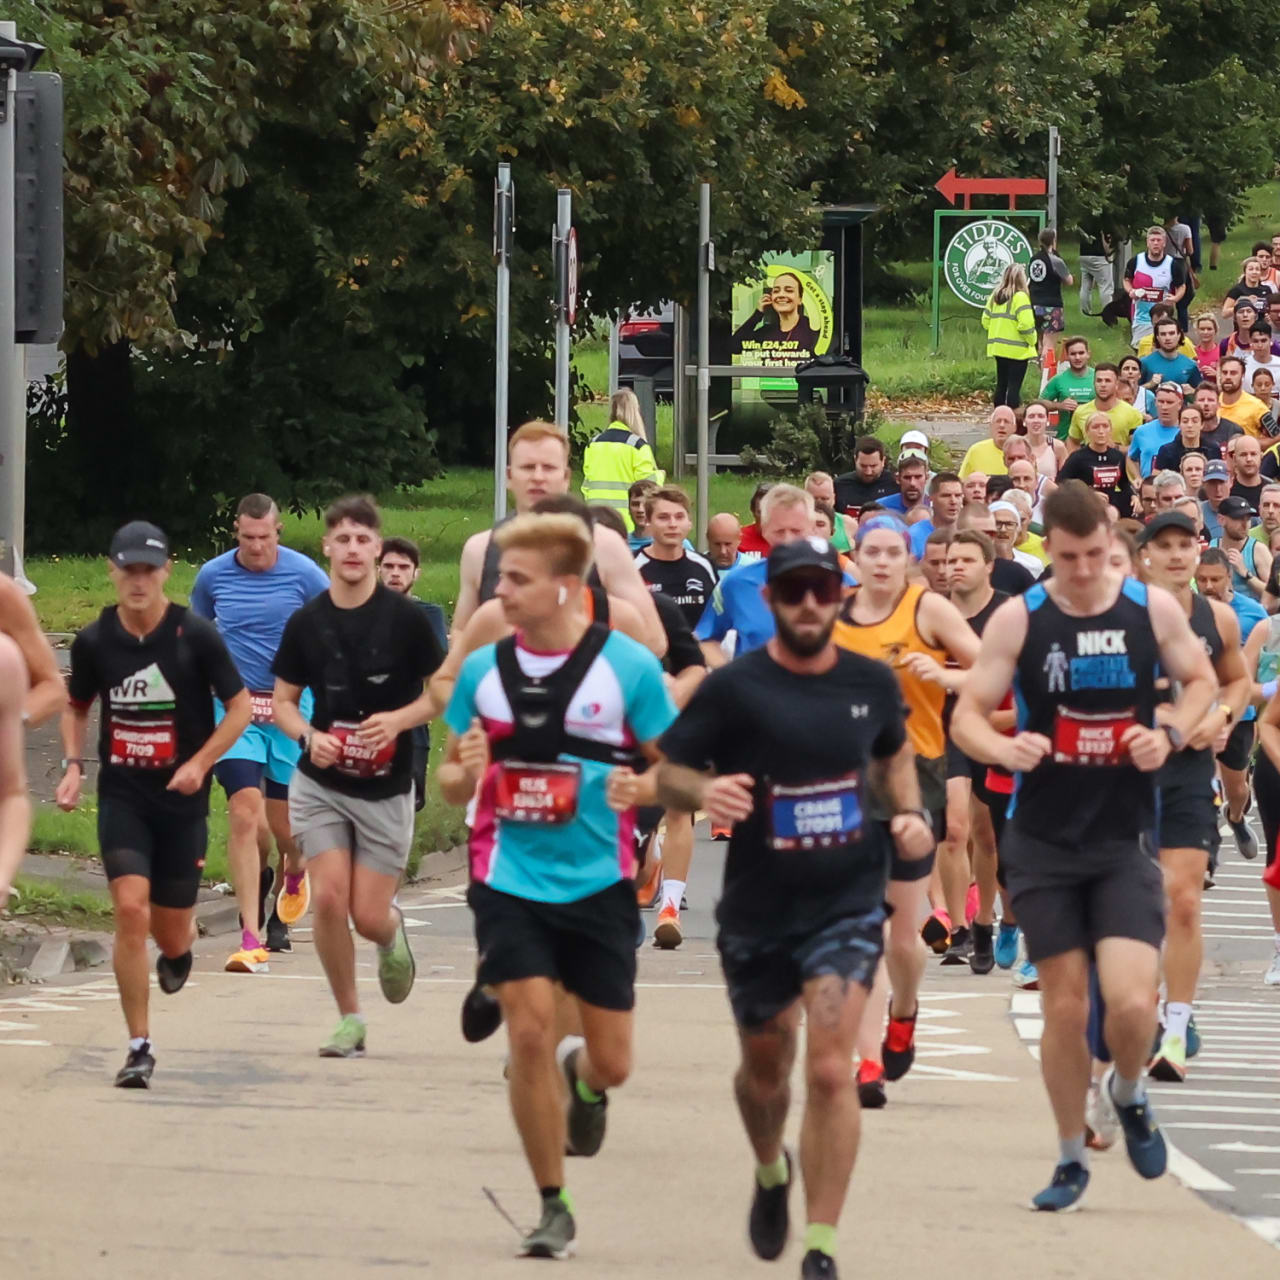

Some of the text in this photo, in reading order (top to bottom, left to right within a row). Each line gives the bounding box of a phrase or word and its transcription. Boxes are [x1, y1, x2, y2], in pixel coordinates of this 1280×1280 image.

[953, 223, 1026, 254] FIDDES
[951, 262, 961, 278] FOR
[955, 275, 971, 296] OVER
[805, 281, 817, 294] Get
[818, 298, 827, 314] step
[823, 316, 831, 339] ahead
[742, 341, 799, 351] Win £24,207
[742, 349, 811, 361] to put towards
[765, 358, 783, 366] first
[1077, 629, 1128, 656] NICK
[1078, 726, 1115, 740] NICK
